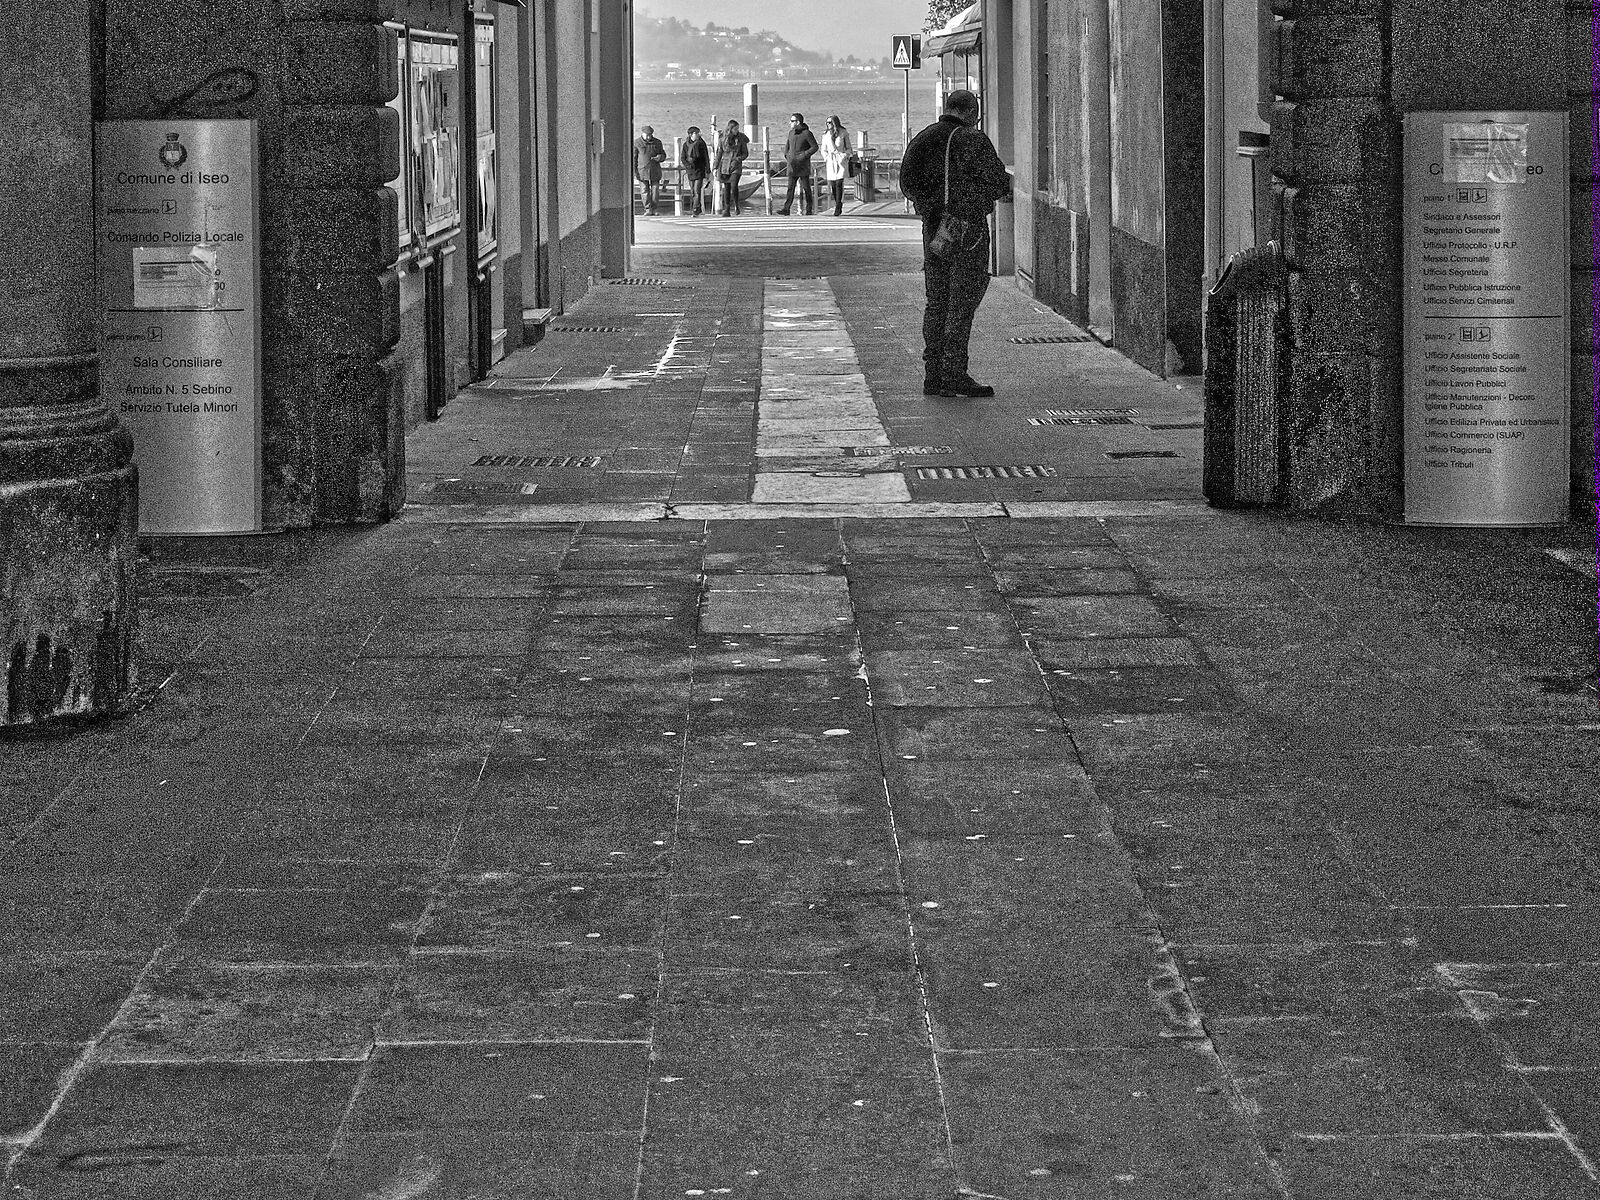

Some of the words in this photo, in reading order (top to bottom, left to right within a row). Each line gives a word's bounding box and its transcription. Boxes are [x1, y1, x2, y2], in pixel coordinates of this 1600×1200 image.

[117, 172, 176, 185] Comune
[180, 171, 193, 185] di
[199, 171, 229, 185] Iseo
[1465, 226, 1500, 234] Generale
[107, 231, 160, 243] Comando
[163, 231, 201, 243] Polizia
[205, 231, 244, 243] Locale
[133, 357, 158, 368] Sala
[162, 356, 223, 368] Consiliare
[126, 384, 162, 395] Ambito
[165, 384, 178, 395] N.
[181, 384, 189, 395] 5
[192, 384, 232, 395] Sebino
[120, 402, 162, 413] Servizio
[165, 402, 200, 413] Tutela
[203, 402, 238, 412] Minori
